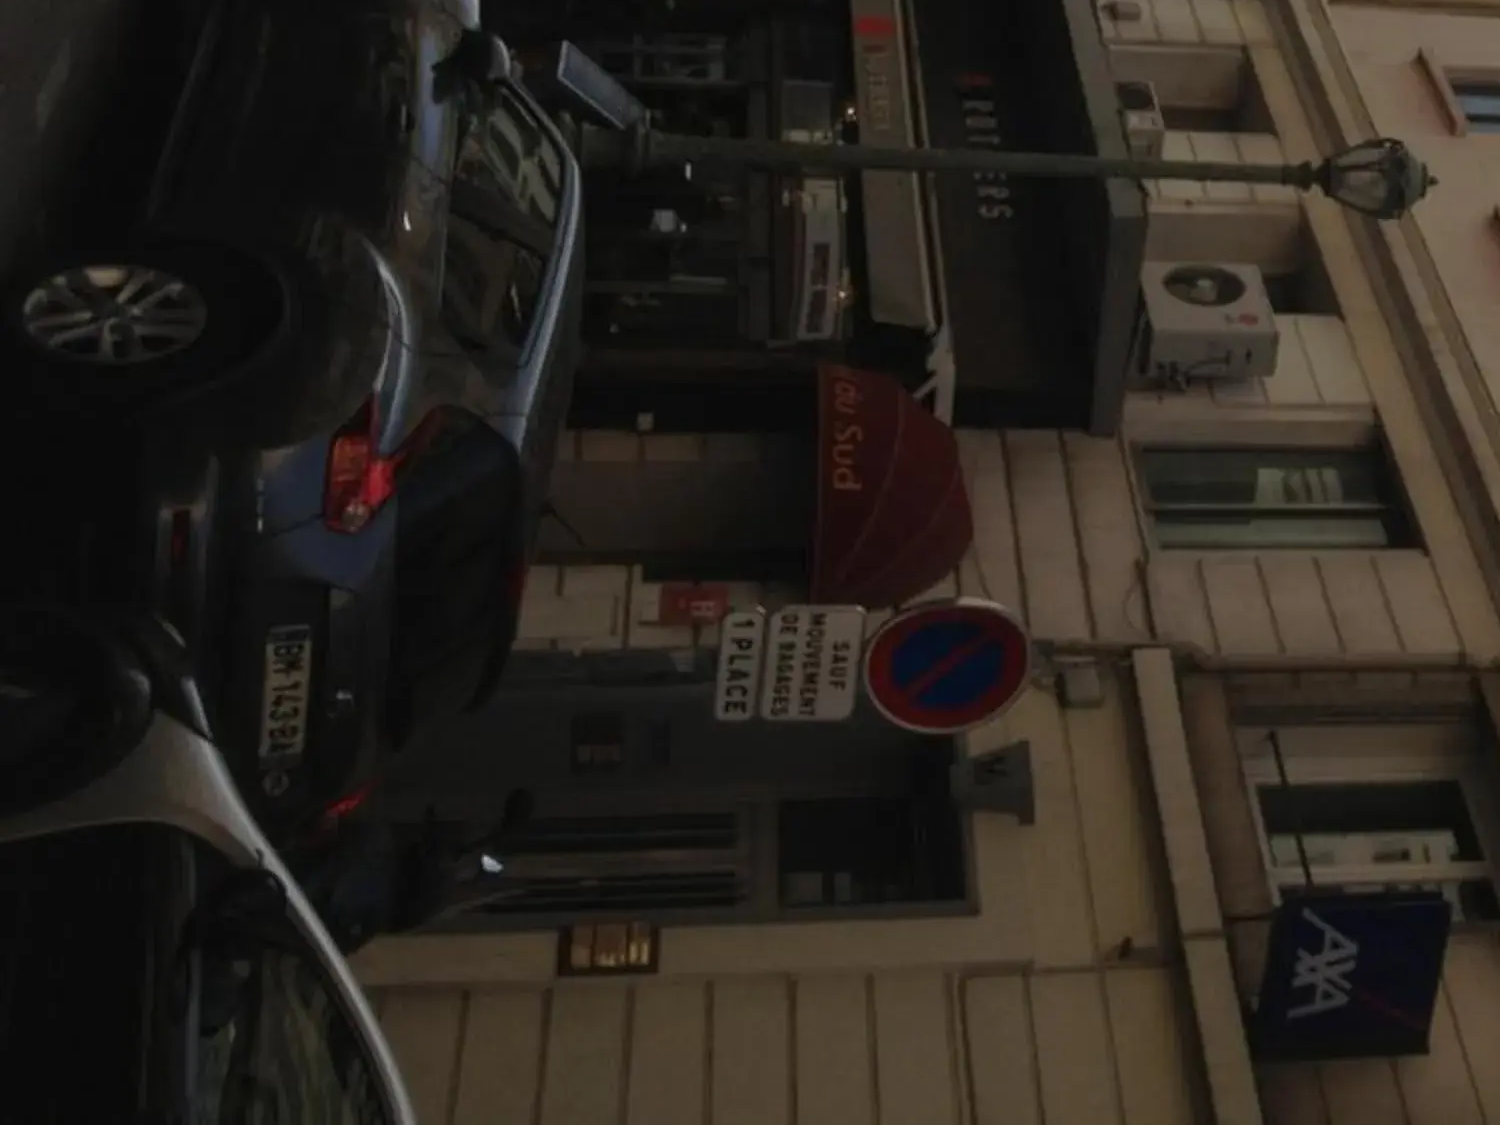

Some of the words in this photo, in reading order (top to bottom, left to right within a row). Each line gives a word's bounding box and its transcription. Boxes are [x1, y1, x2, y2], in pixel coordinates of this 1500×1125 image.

[832, 422, 864, 492] Sud
[732, 619, 756, 628] 1
[781, 614, 799, 634] DE
[724, 638, 754, 714] PLACE
[770, 641, 797, 716] BAGAGES
[799, 613, 828, 716] MOUVEMENT
[829, 640, 851, 691] SAUF
[1286, 906, 1360, 1019] AXA
